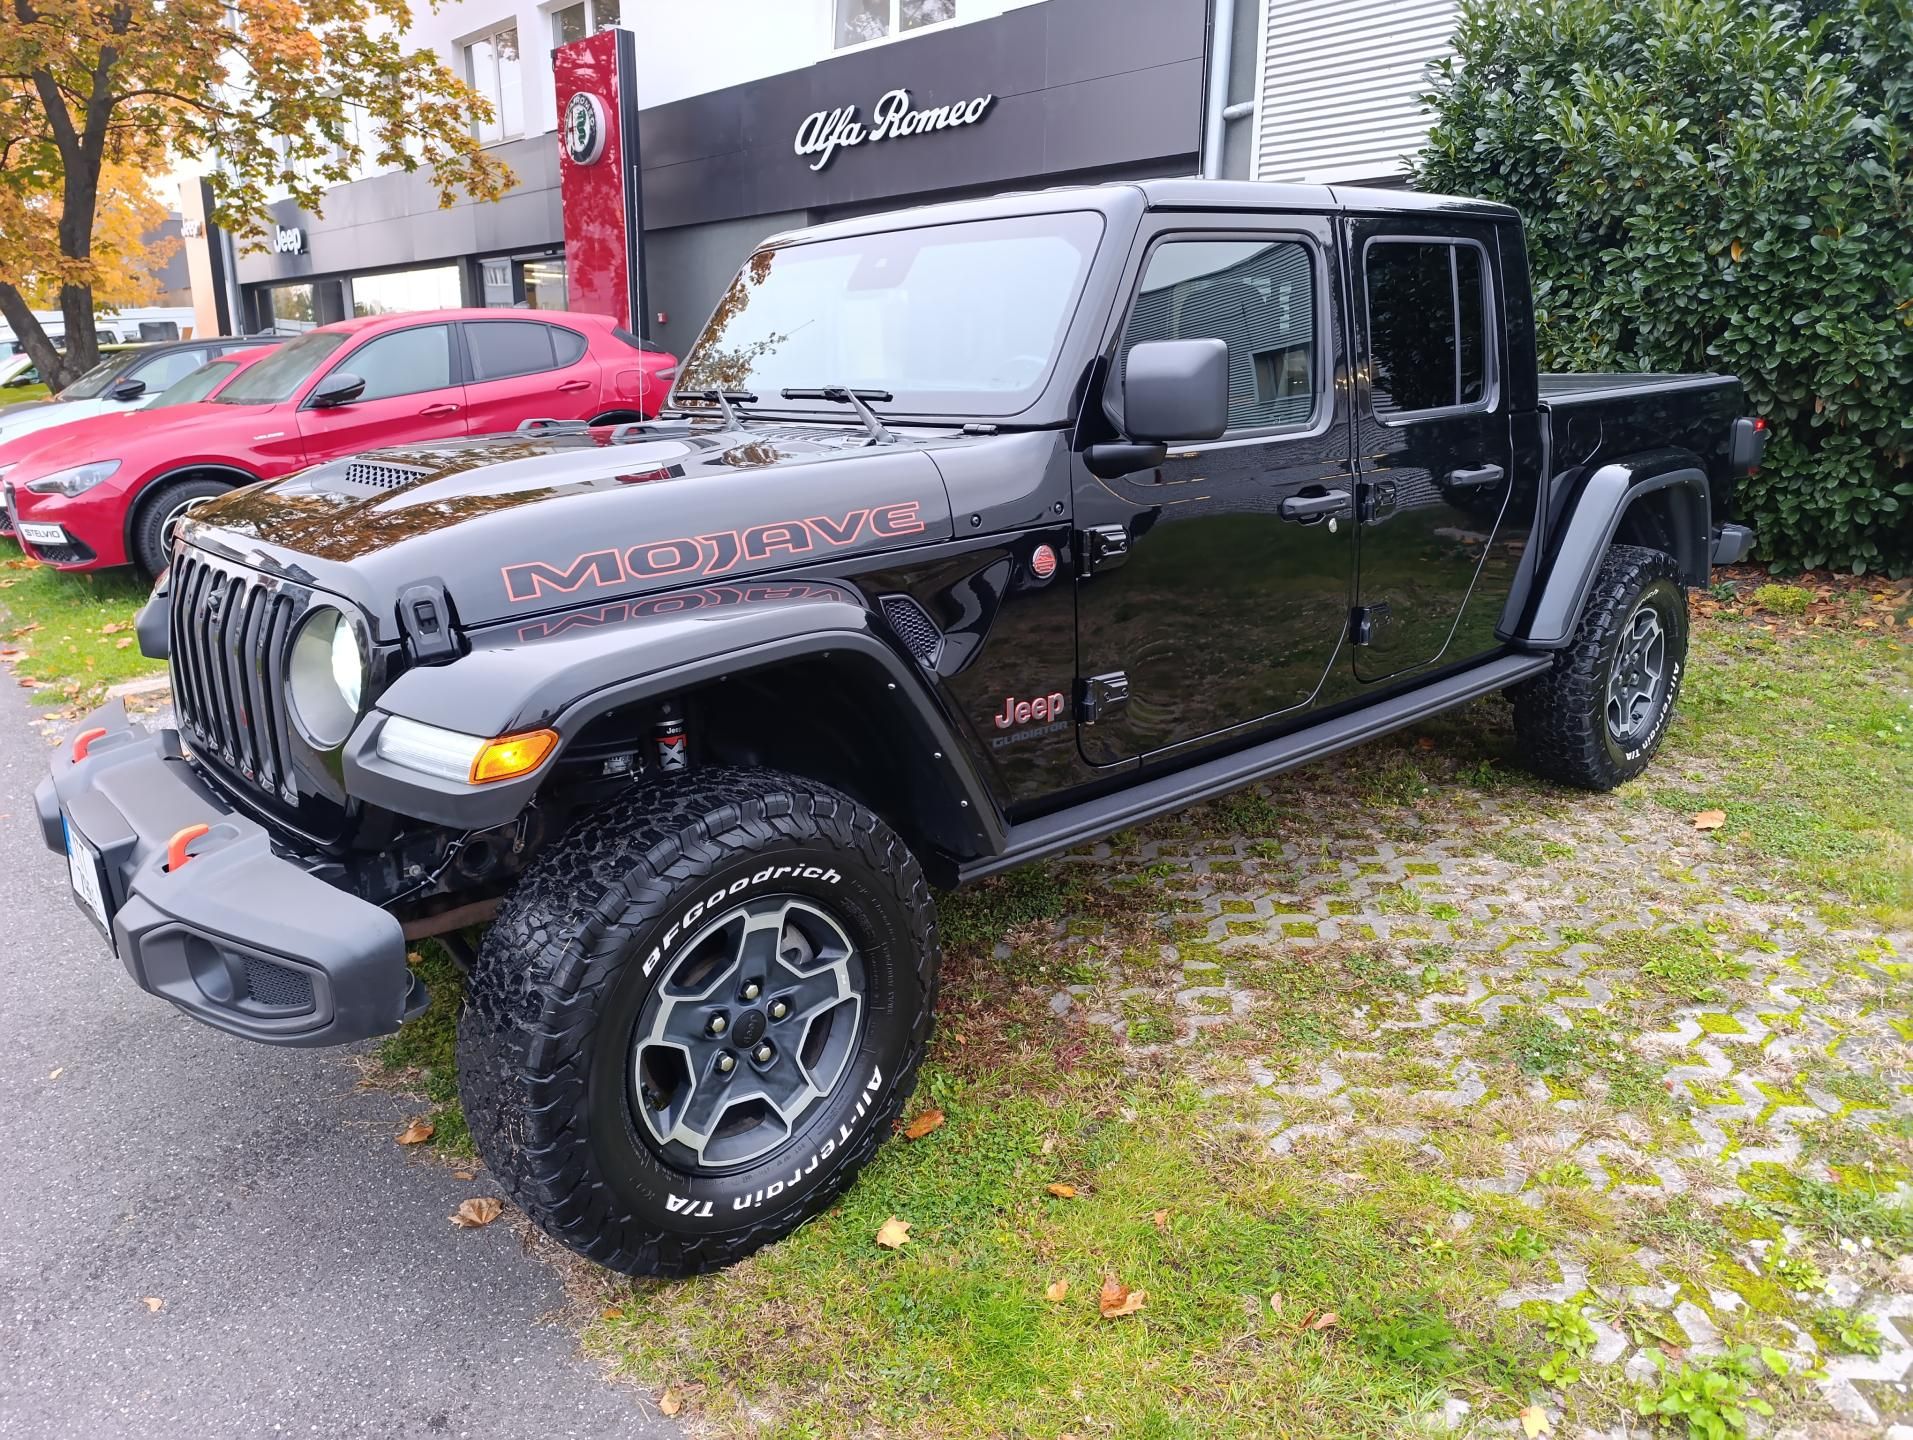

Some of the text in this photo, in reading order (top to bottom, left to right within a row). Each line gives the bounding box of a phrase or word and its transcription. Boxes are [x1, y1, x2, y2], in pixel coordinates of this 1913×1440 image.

[794, 88, 992, 171] Alfa Romeo
[24, 528, 61, 539] STELVIO
[501, 501, 925, 602] MOJAVE
[992, 721, 1068, 748] GLADIATOR
[995, 692, 1065, 729] Jeep
[642, 863, 842, 978] BFGoodrich
[733, 1064, 882, 1211] All-Terrain
[665, 1193, 713, 1217] T/A
